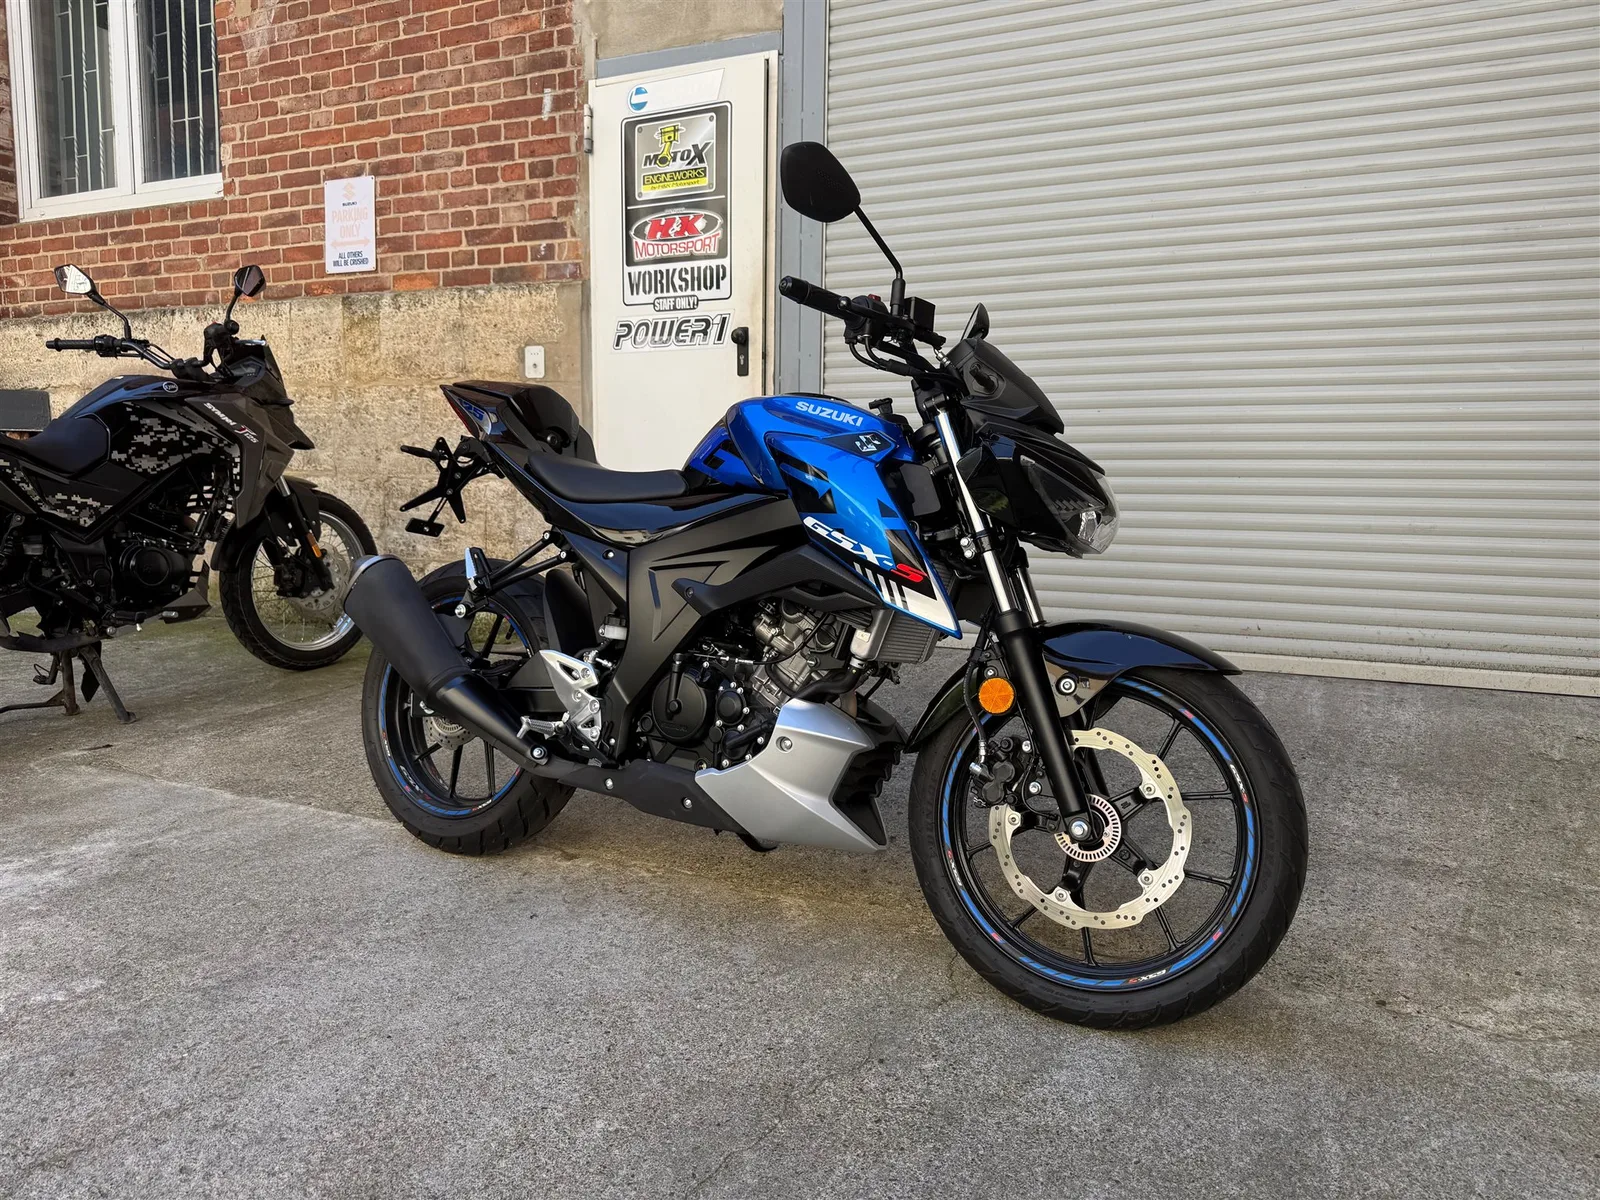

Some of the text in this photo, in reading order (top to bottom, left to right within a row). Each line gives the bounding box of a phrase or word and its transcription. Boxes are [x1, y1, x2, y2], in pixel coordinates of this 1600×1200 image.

[644, 168, 705, 185] ENGINEWORKS
[332, 207, 368, 224] PARKING
[341, 223, 360, 238] ONLY
[347, 251, 362, 259] OTHERS
[634, 233, 720, 260] MOTORSPORT
[628, 264, 727, 296] WORKSHOP
[655, 296, 697, 311] STAFF ONLY!
[613, 313, 731, 350] POWER1
[795, 401, 863, 427] SUZUKI
[803, 516, 928, 582] GSX-S
